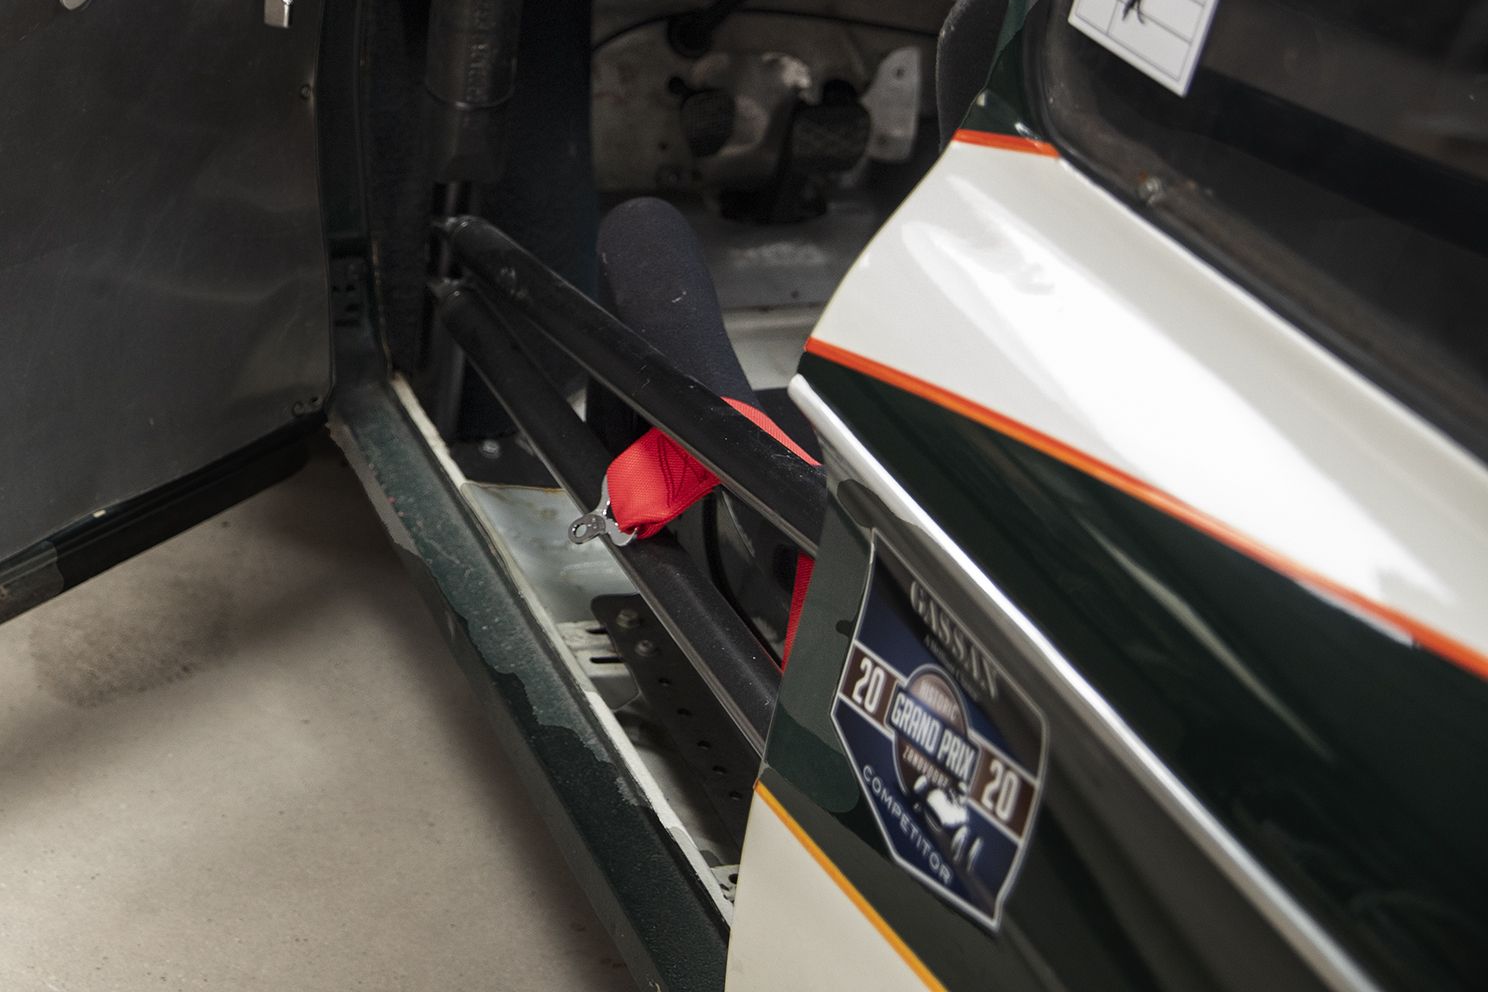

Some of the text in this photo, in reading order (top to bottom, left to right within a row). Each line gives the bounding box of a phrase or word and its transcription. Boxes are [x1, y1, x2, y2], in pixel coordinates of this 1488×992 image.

[910, 579, 1000, 701] GASSAN
[851, 657, 887, 715] 20
[919, 677, 961, 722] HISTORIC
[890, 690, 979, 784] GRAND PRIX
[862, 763, 953, 886] COMPETITOR
[980, 758, 1021, 823] 20
